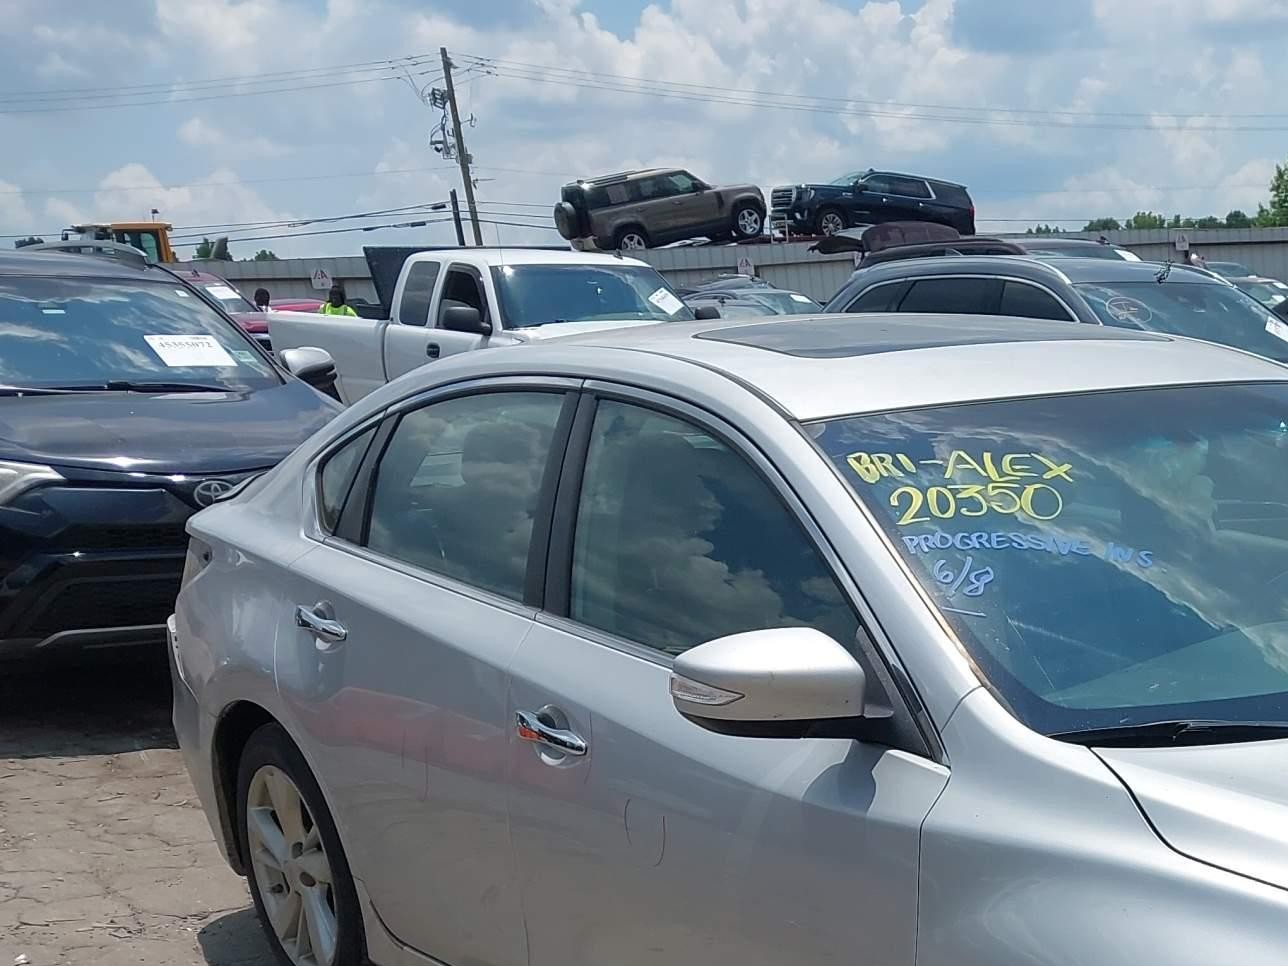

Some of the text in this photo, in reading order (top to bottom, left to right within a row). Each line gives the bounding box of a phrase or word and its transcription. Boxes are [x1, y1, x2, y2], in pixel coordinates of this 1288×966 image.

[847, 450, 1074, 483] BRI-ALEX
[890, 483, 1064, 525] 20350
[902, 532, 1090, 555] PROGRESSIVE
[933, 556, 994, 599] 6/8
